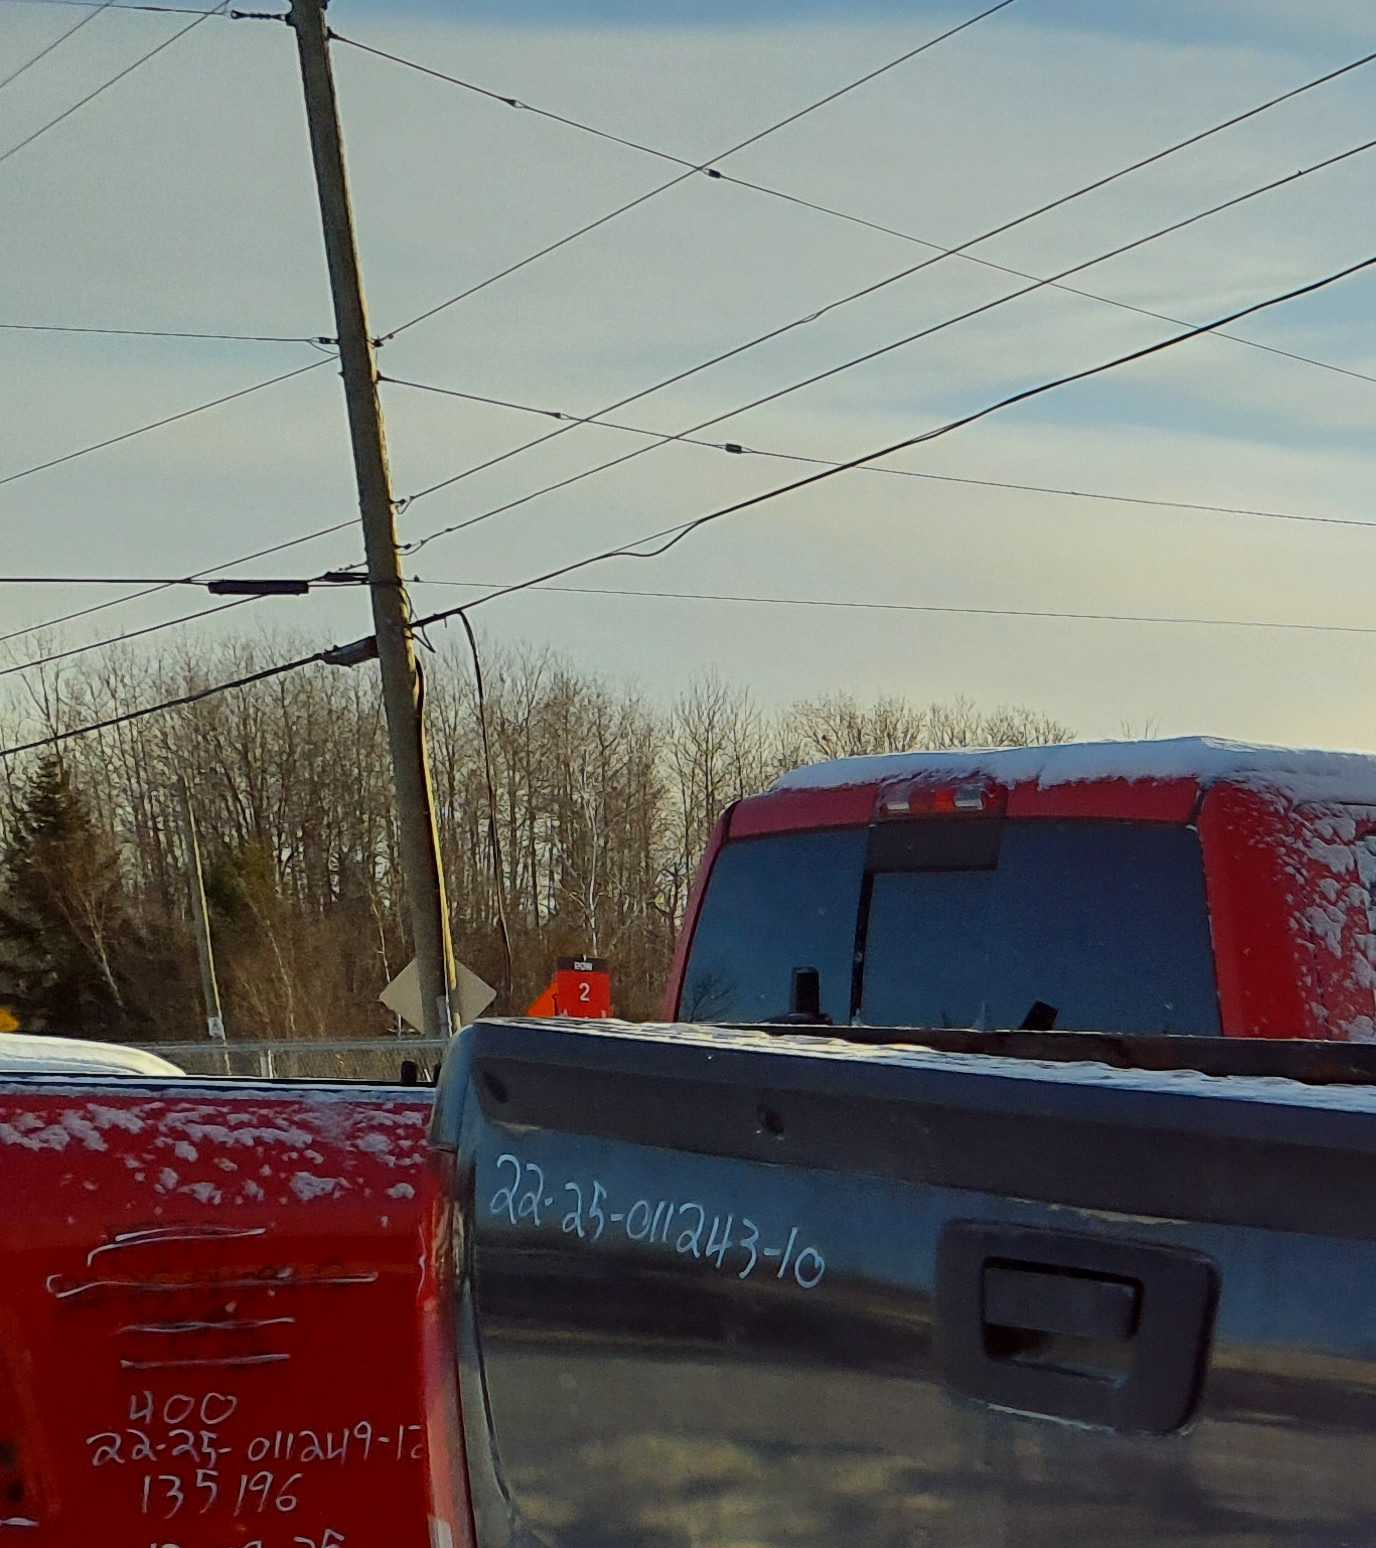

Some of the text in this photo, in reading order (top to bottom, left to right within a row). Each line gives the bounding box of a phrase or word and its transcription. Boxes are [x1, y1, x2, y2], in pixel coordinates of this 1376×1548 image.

[579, 982, 591, 1002] 2
[490, 1154, 826, 1289] 22-25-011243-10
[129, 1391, 238, 1425] 400
